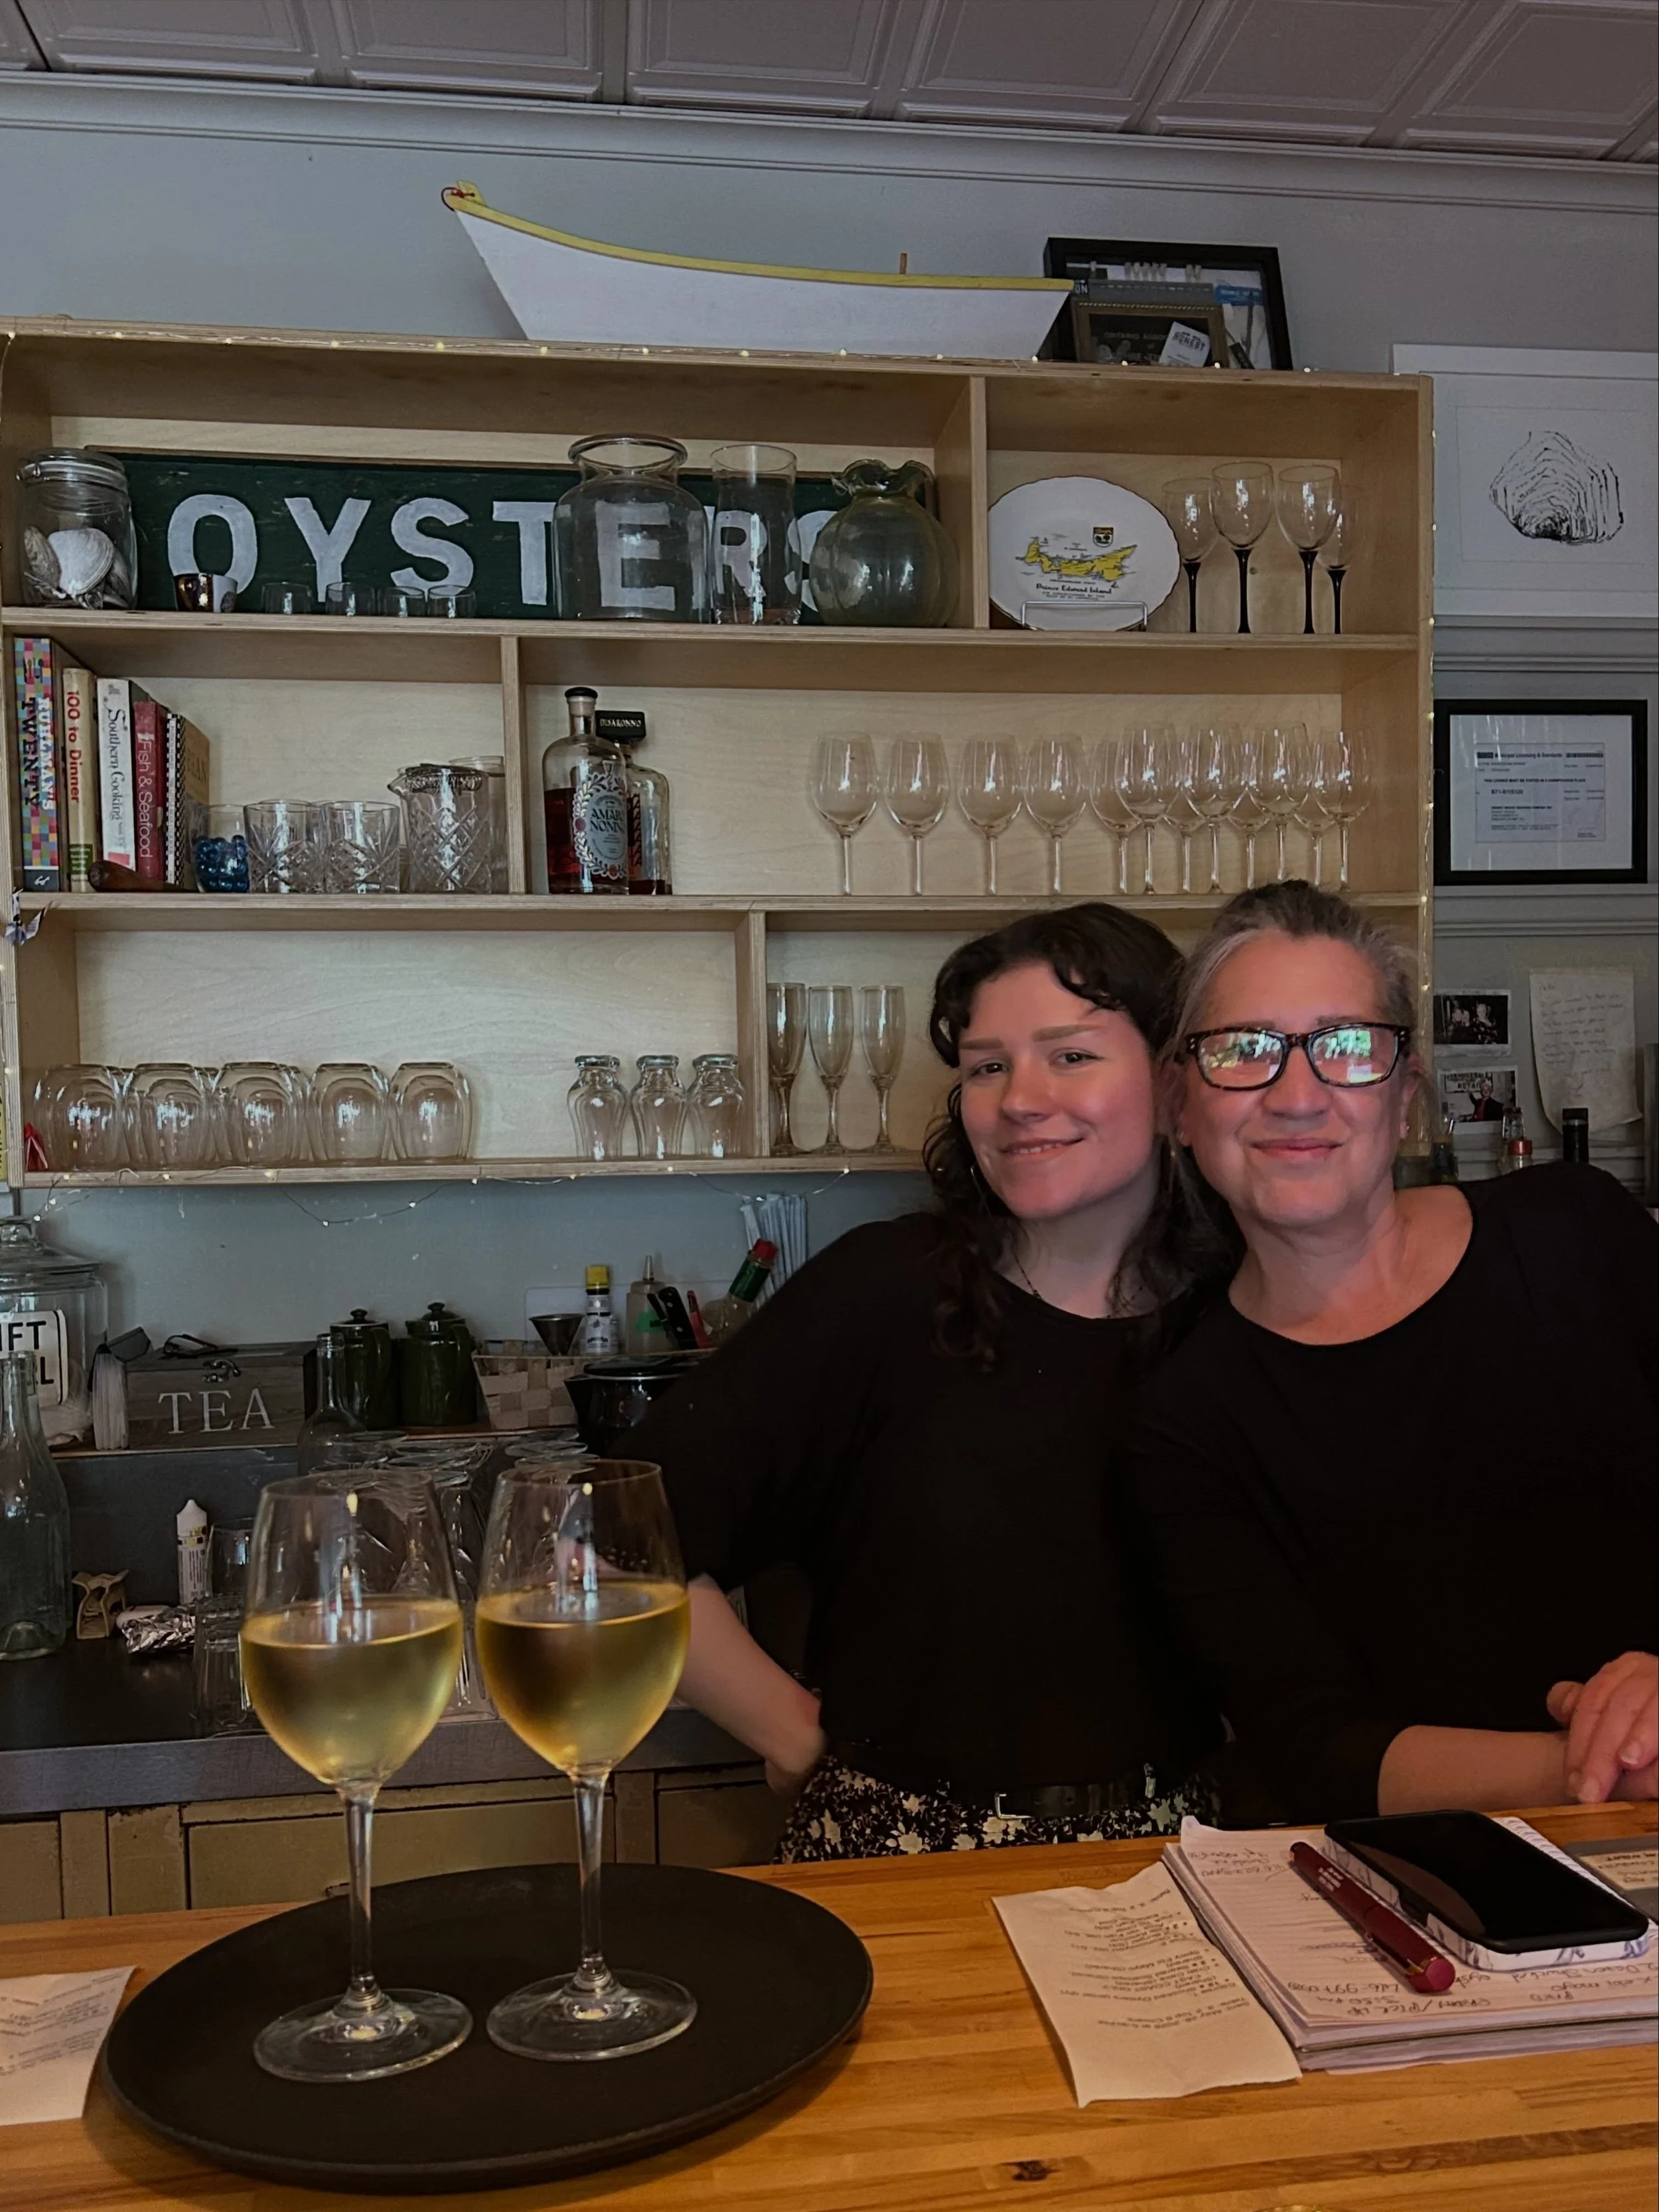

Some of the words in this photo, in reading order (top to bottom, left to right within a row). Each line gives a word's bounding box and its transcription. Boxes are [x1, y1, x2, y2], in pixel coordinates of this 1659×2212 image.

[66, 690, 80, 719] 100
[600, 718, 642, 727] DISARONNO
[21, 697, 40, 808] TWENTY
[37, 698, 54, 810] RUHLMAN'S
[68, 726, 79, 743] to
[108, 708, 127, 769] Southern
[138, 740, 152, 771] Fish
[68, 749, 82, 802] Dinner
[109, 771, 125, 821] Cooking
[139, 776, 152, 788] &
[138, 792, 153, 857] Seafood
[159, 1388, 275, 1434] TEA
[1551, 1982, 1600, 1992] mayo
